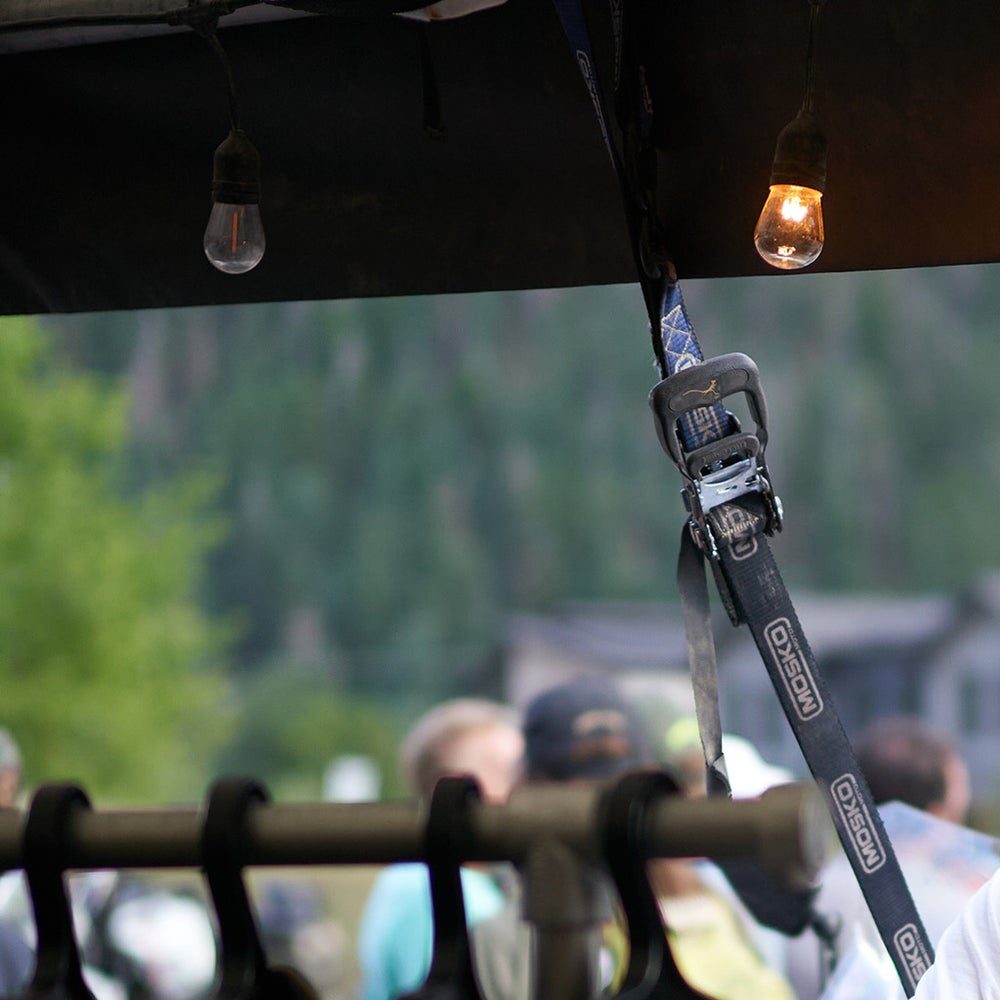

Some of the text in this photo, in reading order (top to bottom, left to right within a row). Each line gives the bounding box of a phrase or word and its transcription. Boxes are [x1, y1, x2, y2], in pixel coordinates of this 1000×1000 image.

[770, 624, 817, 714] MOSKO
[835, 780, 880, 866] MOSKO
[899, 931, 928, 981] SKO
